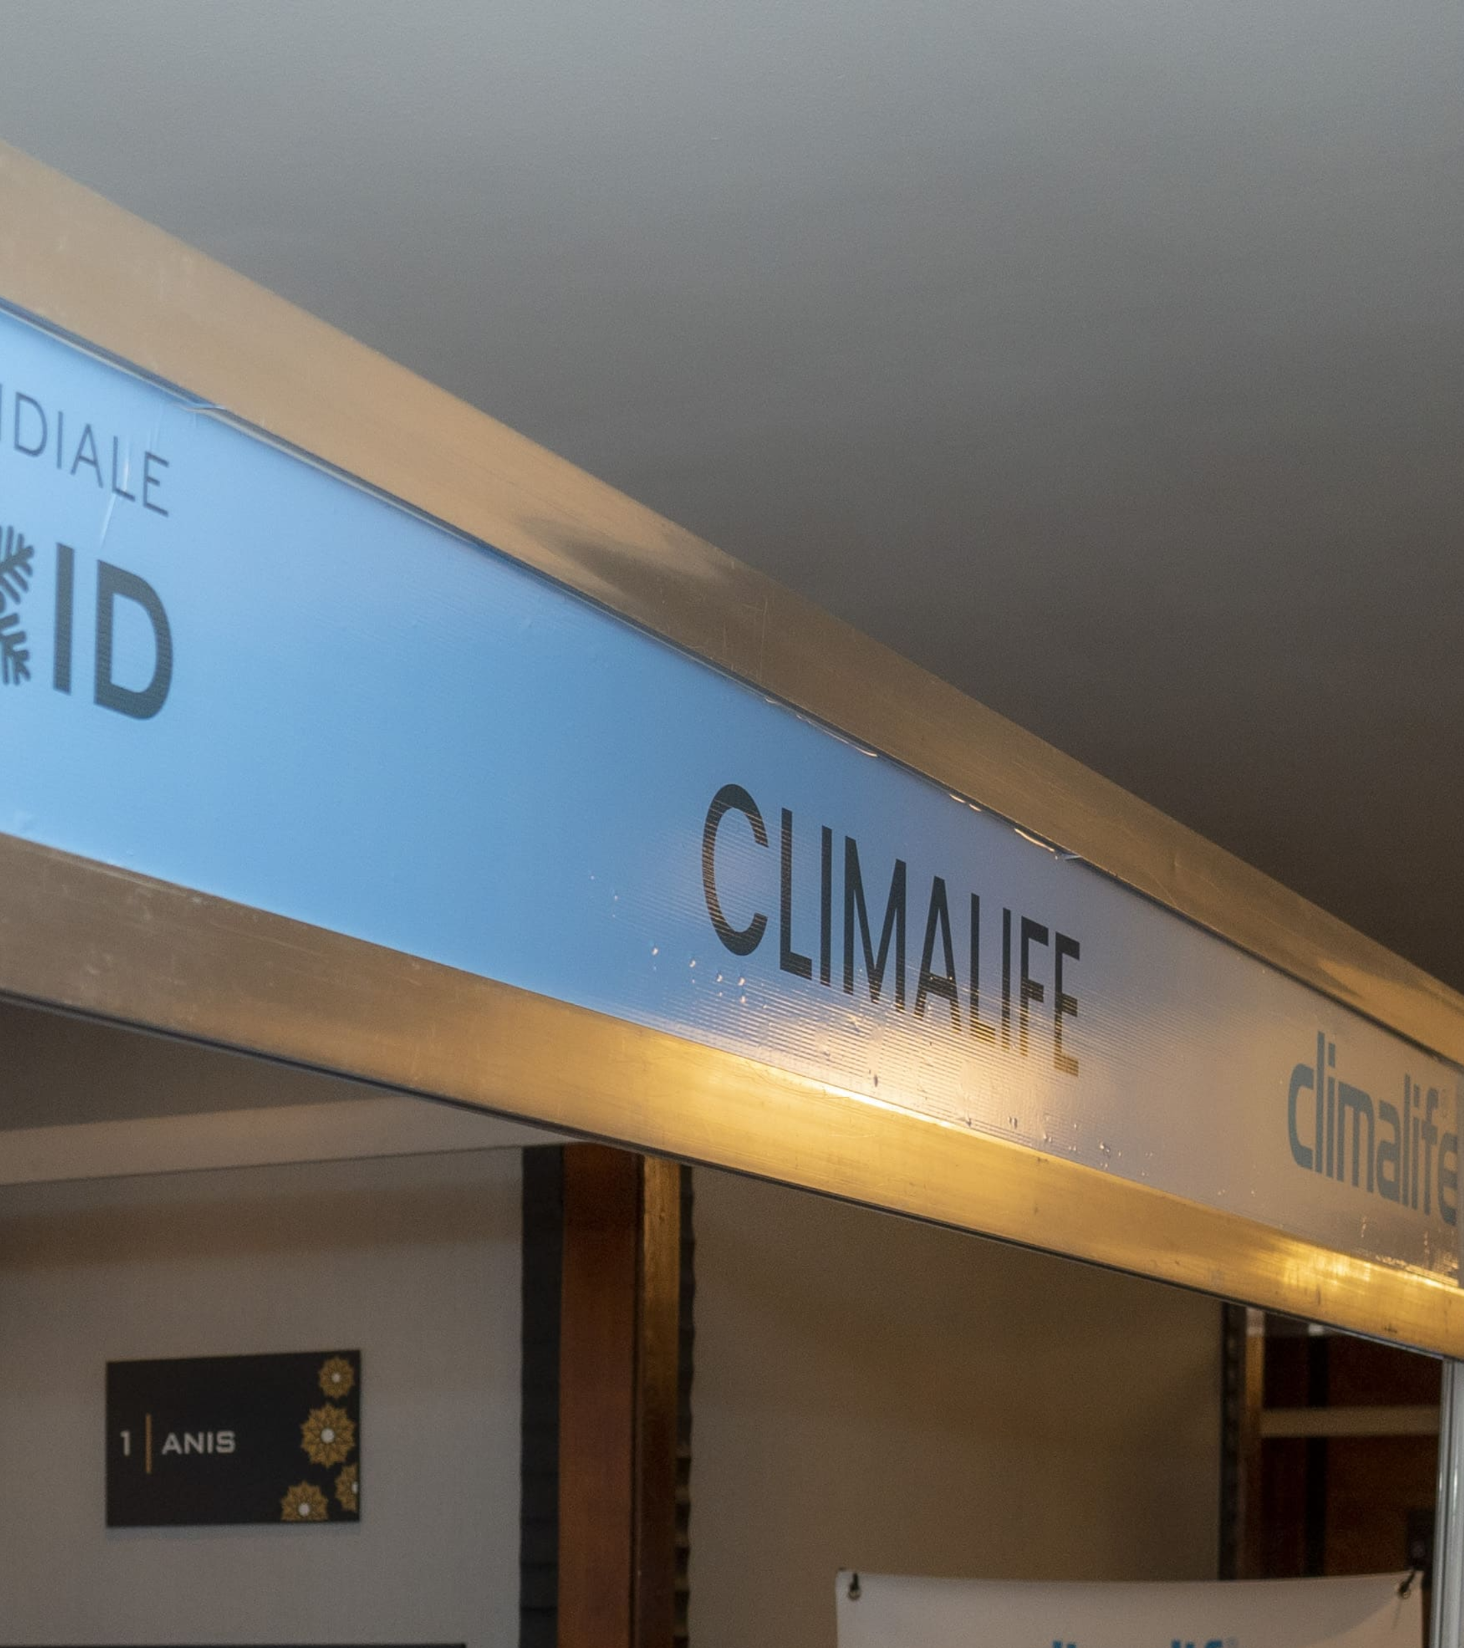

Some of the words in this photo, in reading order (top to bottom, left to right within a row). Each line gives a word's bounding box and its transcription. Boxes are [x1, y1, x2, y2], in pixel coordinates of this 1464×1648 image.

[700, 783, 1081, 1078] CLIMALIFE
[120, 1430, 132, 1456] 1
[161, 1430, 237, 1454] ANIS
